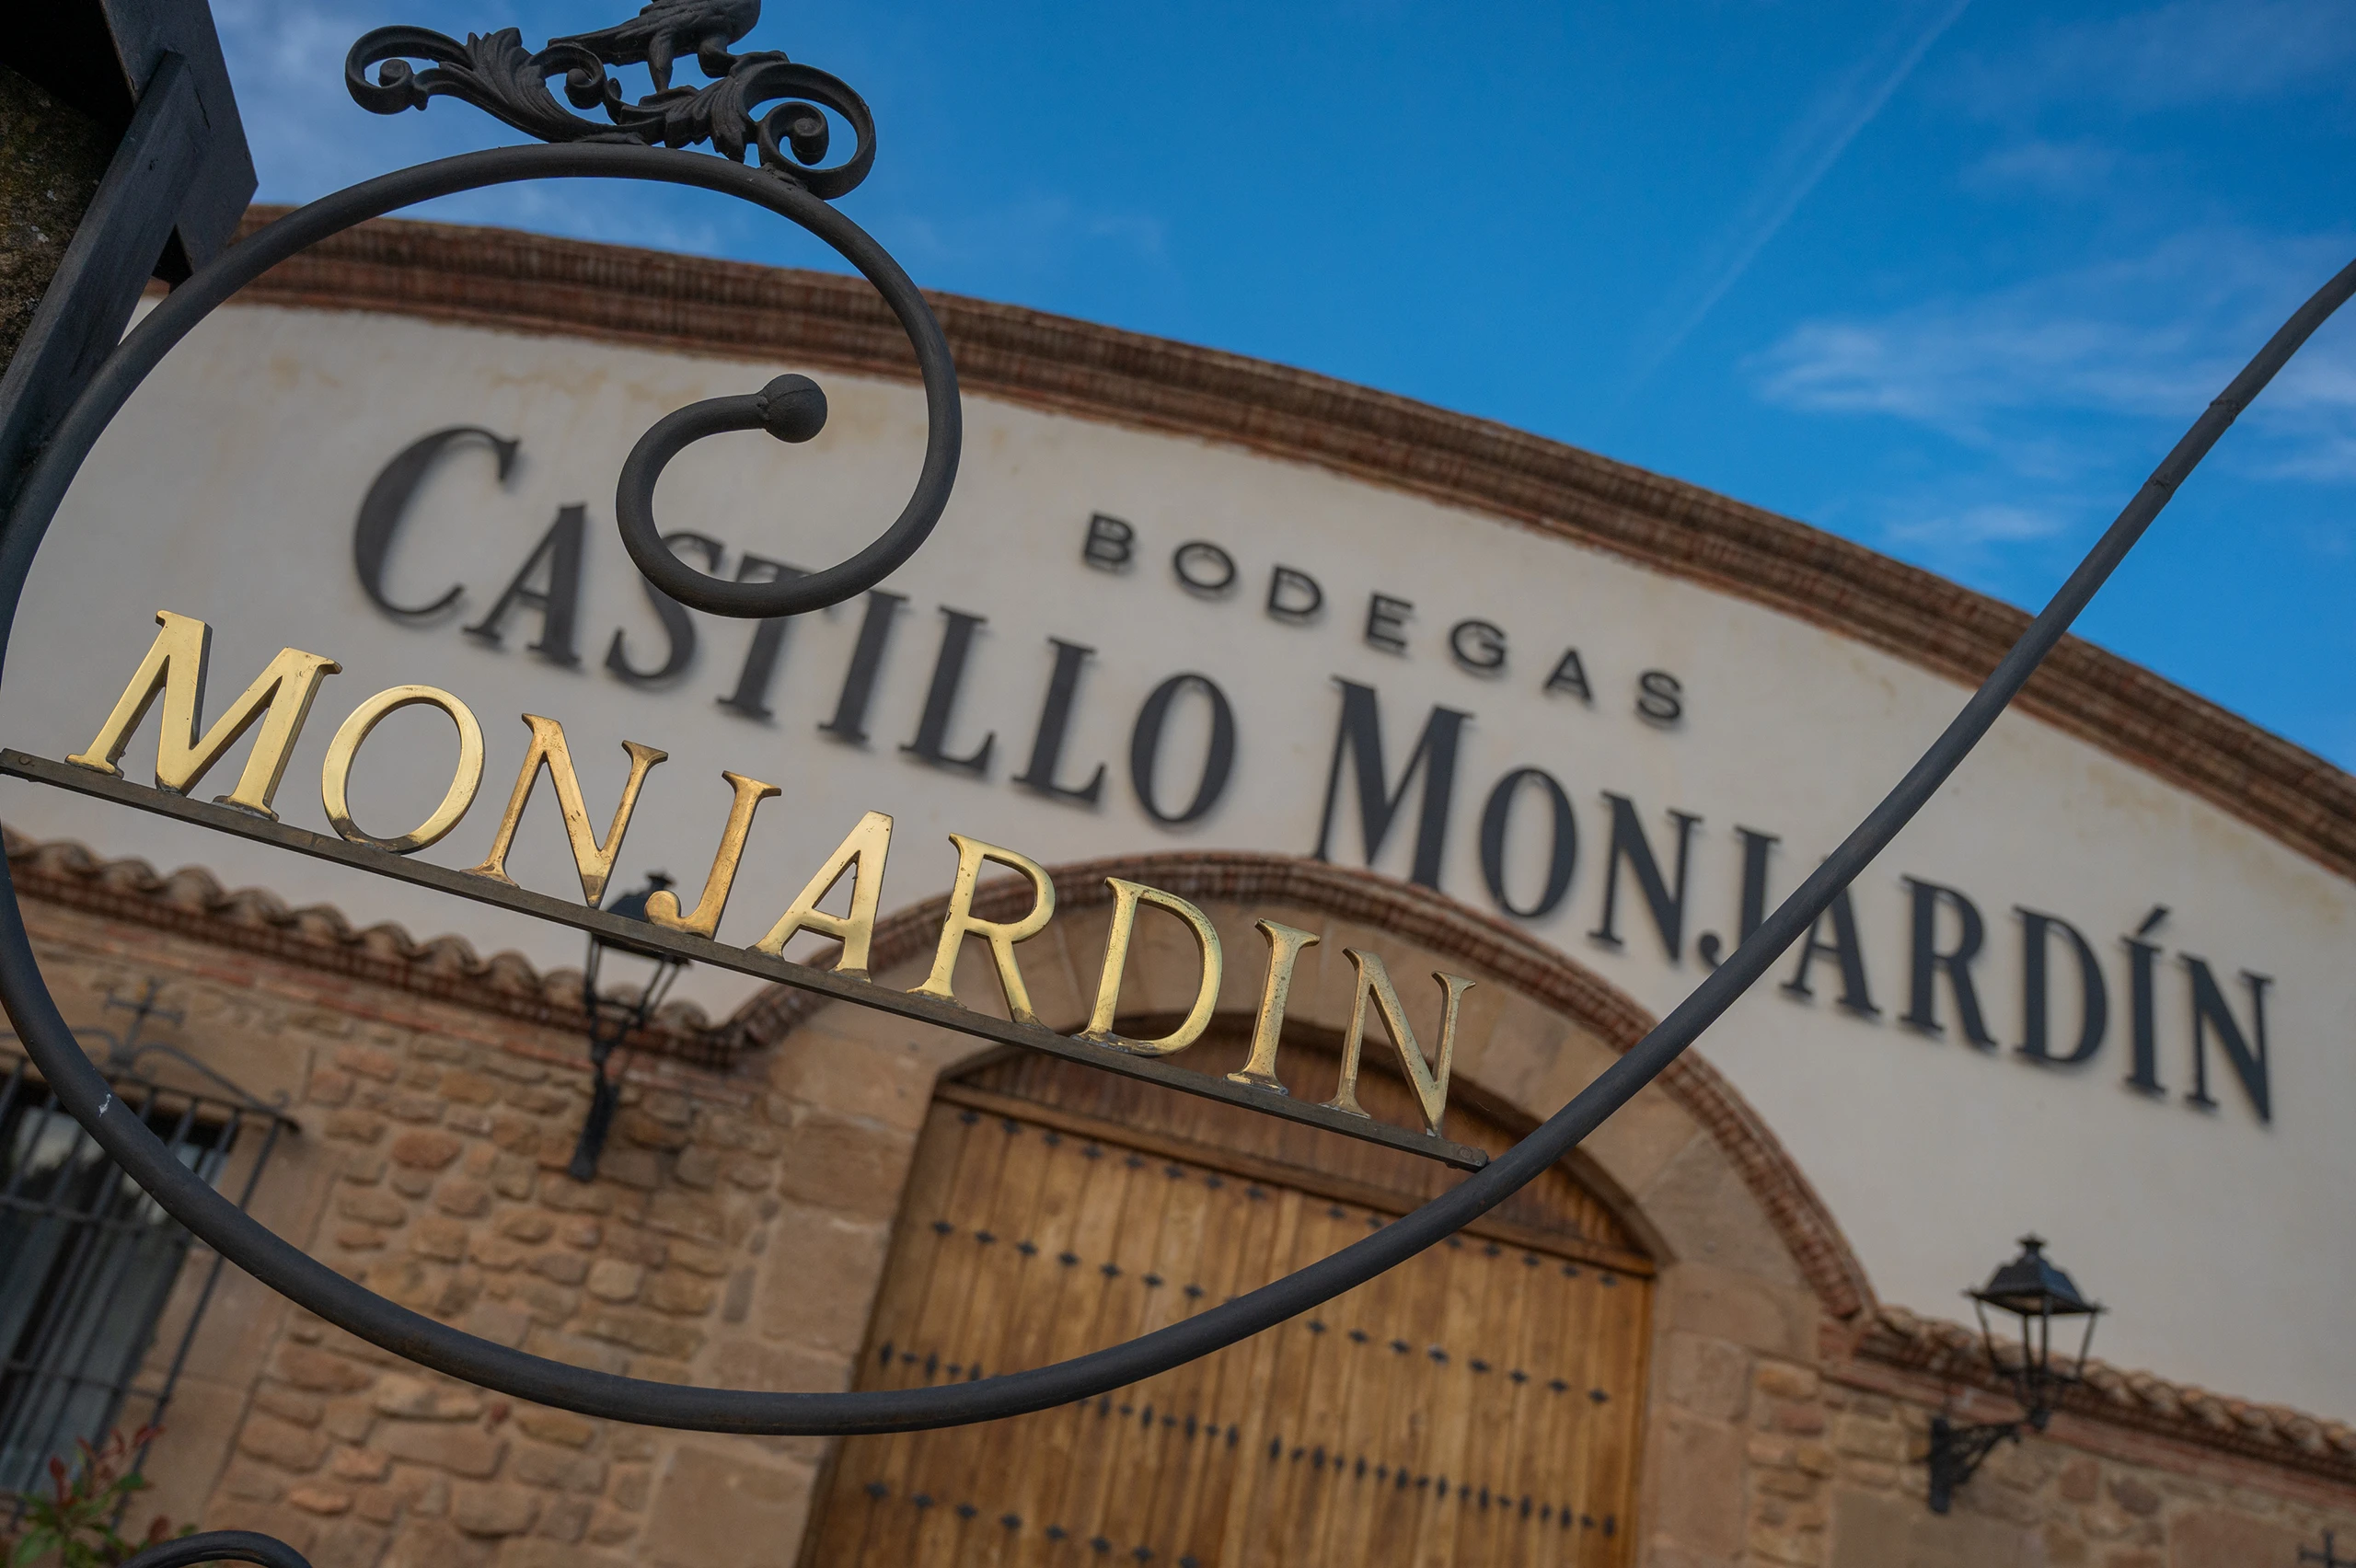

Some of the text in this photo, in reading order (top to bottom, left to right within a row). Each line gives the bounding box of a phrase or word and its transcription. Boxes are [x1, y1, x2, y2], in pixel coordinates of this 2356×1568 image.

[64, 609, 1476, 1138] MONJARDIN
[352, 427, 2273, 1124] CASTILLO MONJARDÍN
[1082, 513, 1683, 723] BODEGAS
